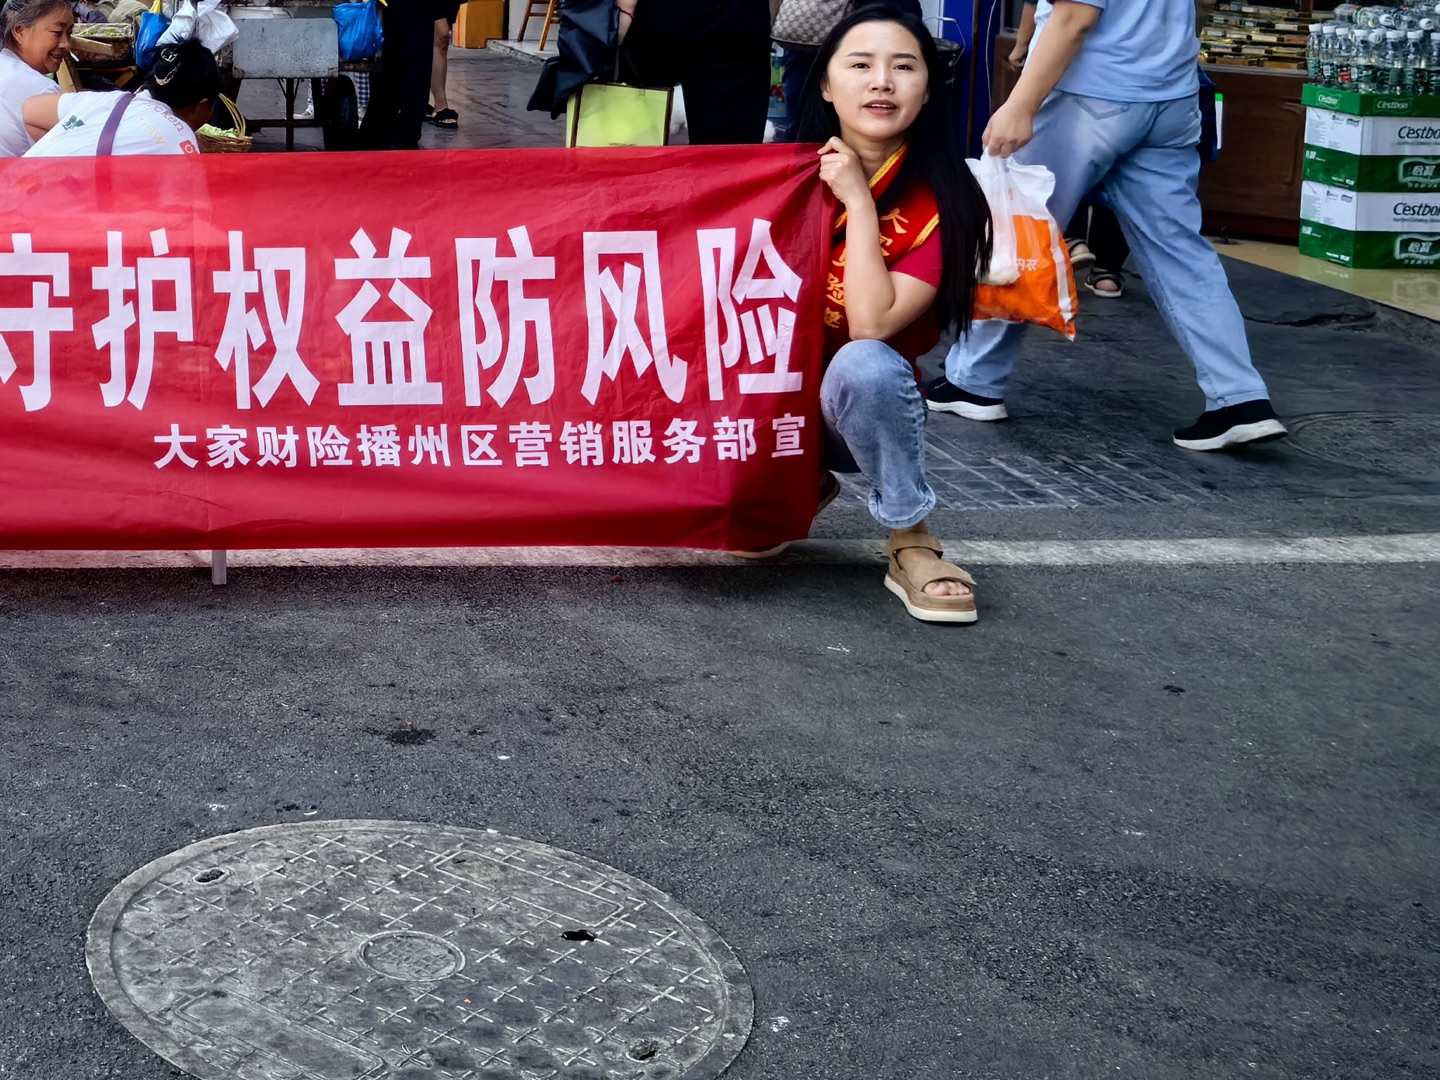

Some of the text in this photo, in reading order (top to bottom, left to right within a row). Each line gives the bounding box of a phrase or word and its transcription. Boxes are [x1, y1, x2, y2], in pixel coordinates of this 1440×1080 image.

[153, 412, 805, 470] 大家财险播州区营销服务部 宣
